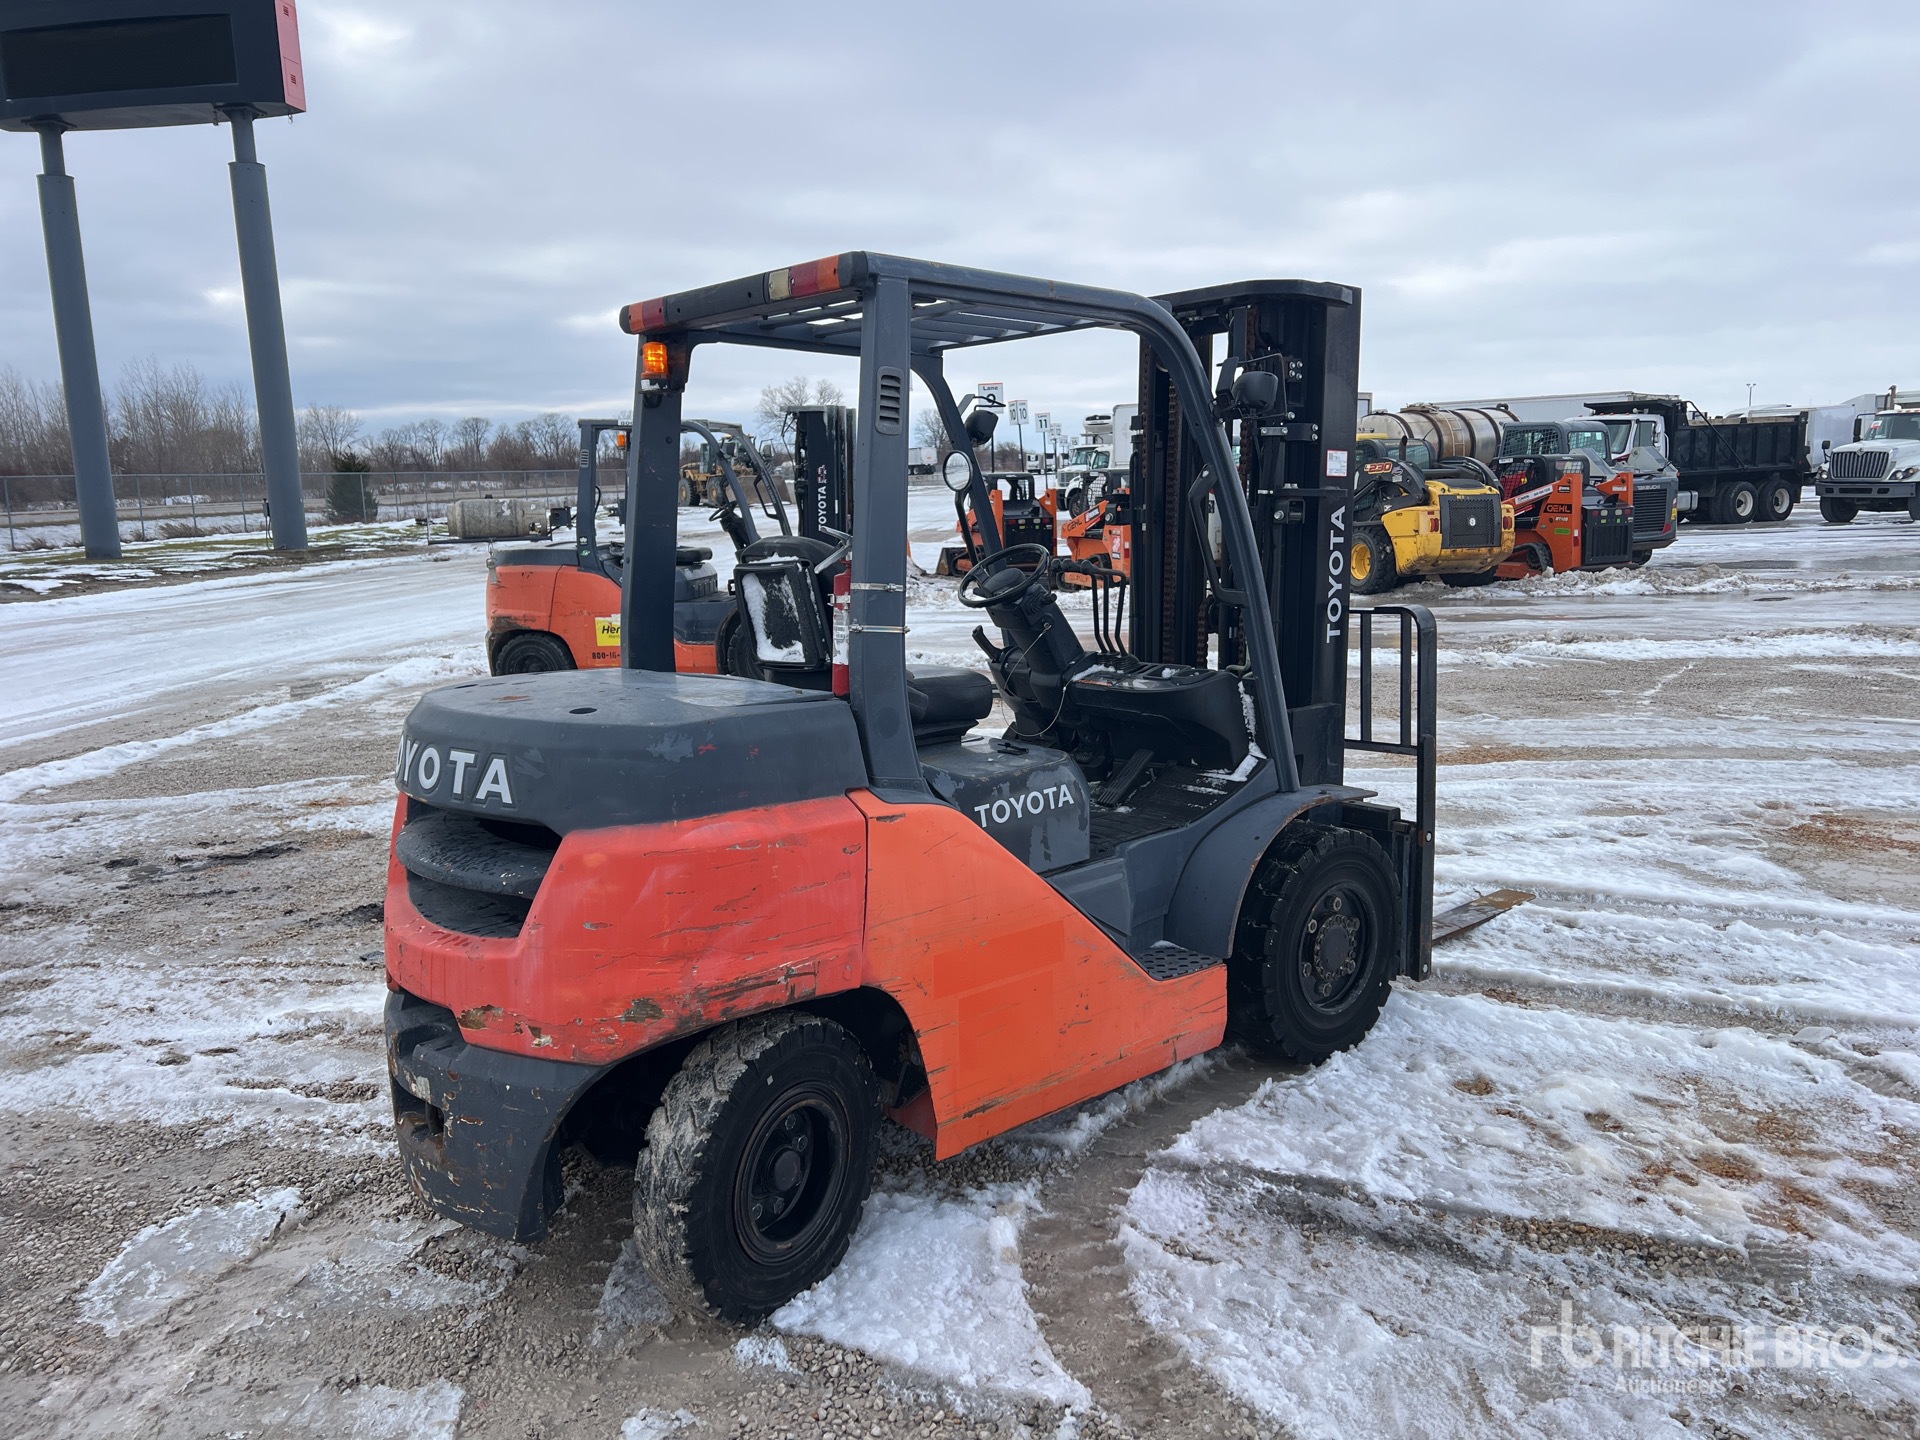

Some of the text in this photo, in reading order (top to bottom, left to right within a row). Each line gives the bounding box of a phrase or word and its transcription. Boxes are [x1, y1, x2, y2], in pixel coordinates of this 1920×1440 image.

[1018, 408, 1027, 419] 10
[1039, 419, 1047, 428] 11
[1546, 504, 1571, 513] GEHL
[1326, 505, 1346, 644] TOYOTA
[974, 784, 1075, 828] TOYOTA
